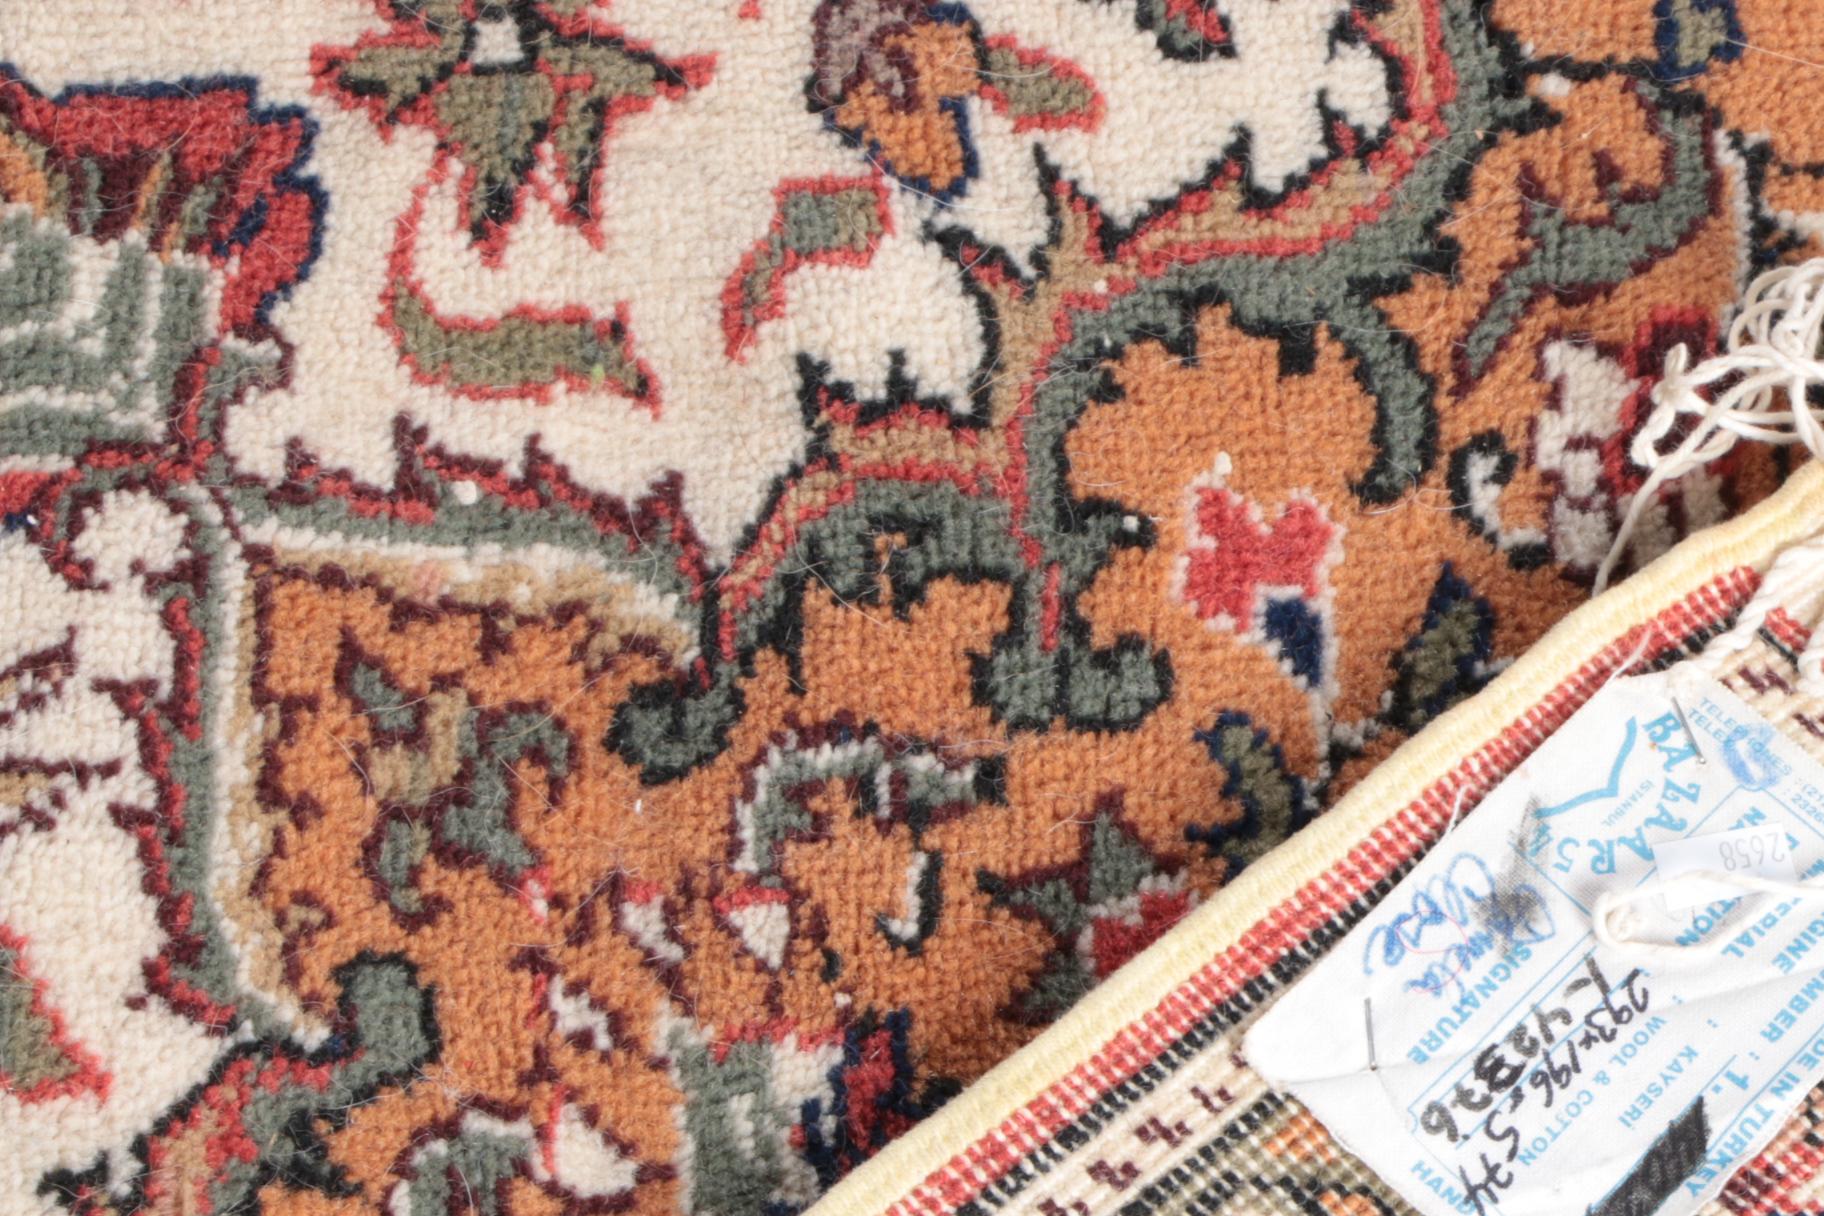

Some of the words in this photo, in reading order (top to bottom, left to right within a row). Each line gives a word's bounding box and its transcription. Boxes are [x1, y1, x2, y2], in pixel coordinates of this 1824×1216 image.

[1588, 712, 1699, 874] BAZAAR
[1718, 832, 1786, 872] 2658
[1404, 939, 1534, 1069] SIGNATURE
[1607, 1012, 1667, 1072] WOOL
[1590, 1067, 1612, 1090] &
[1768, 1069, 1801, 1101] IN
[1515, 1086, 1596, 1168] COTTON
[1681, 1100, 1774, 1199] TURKEY
